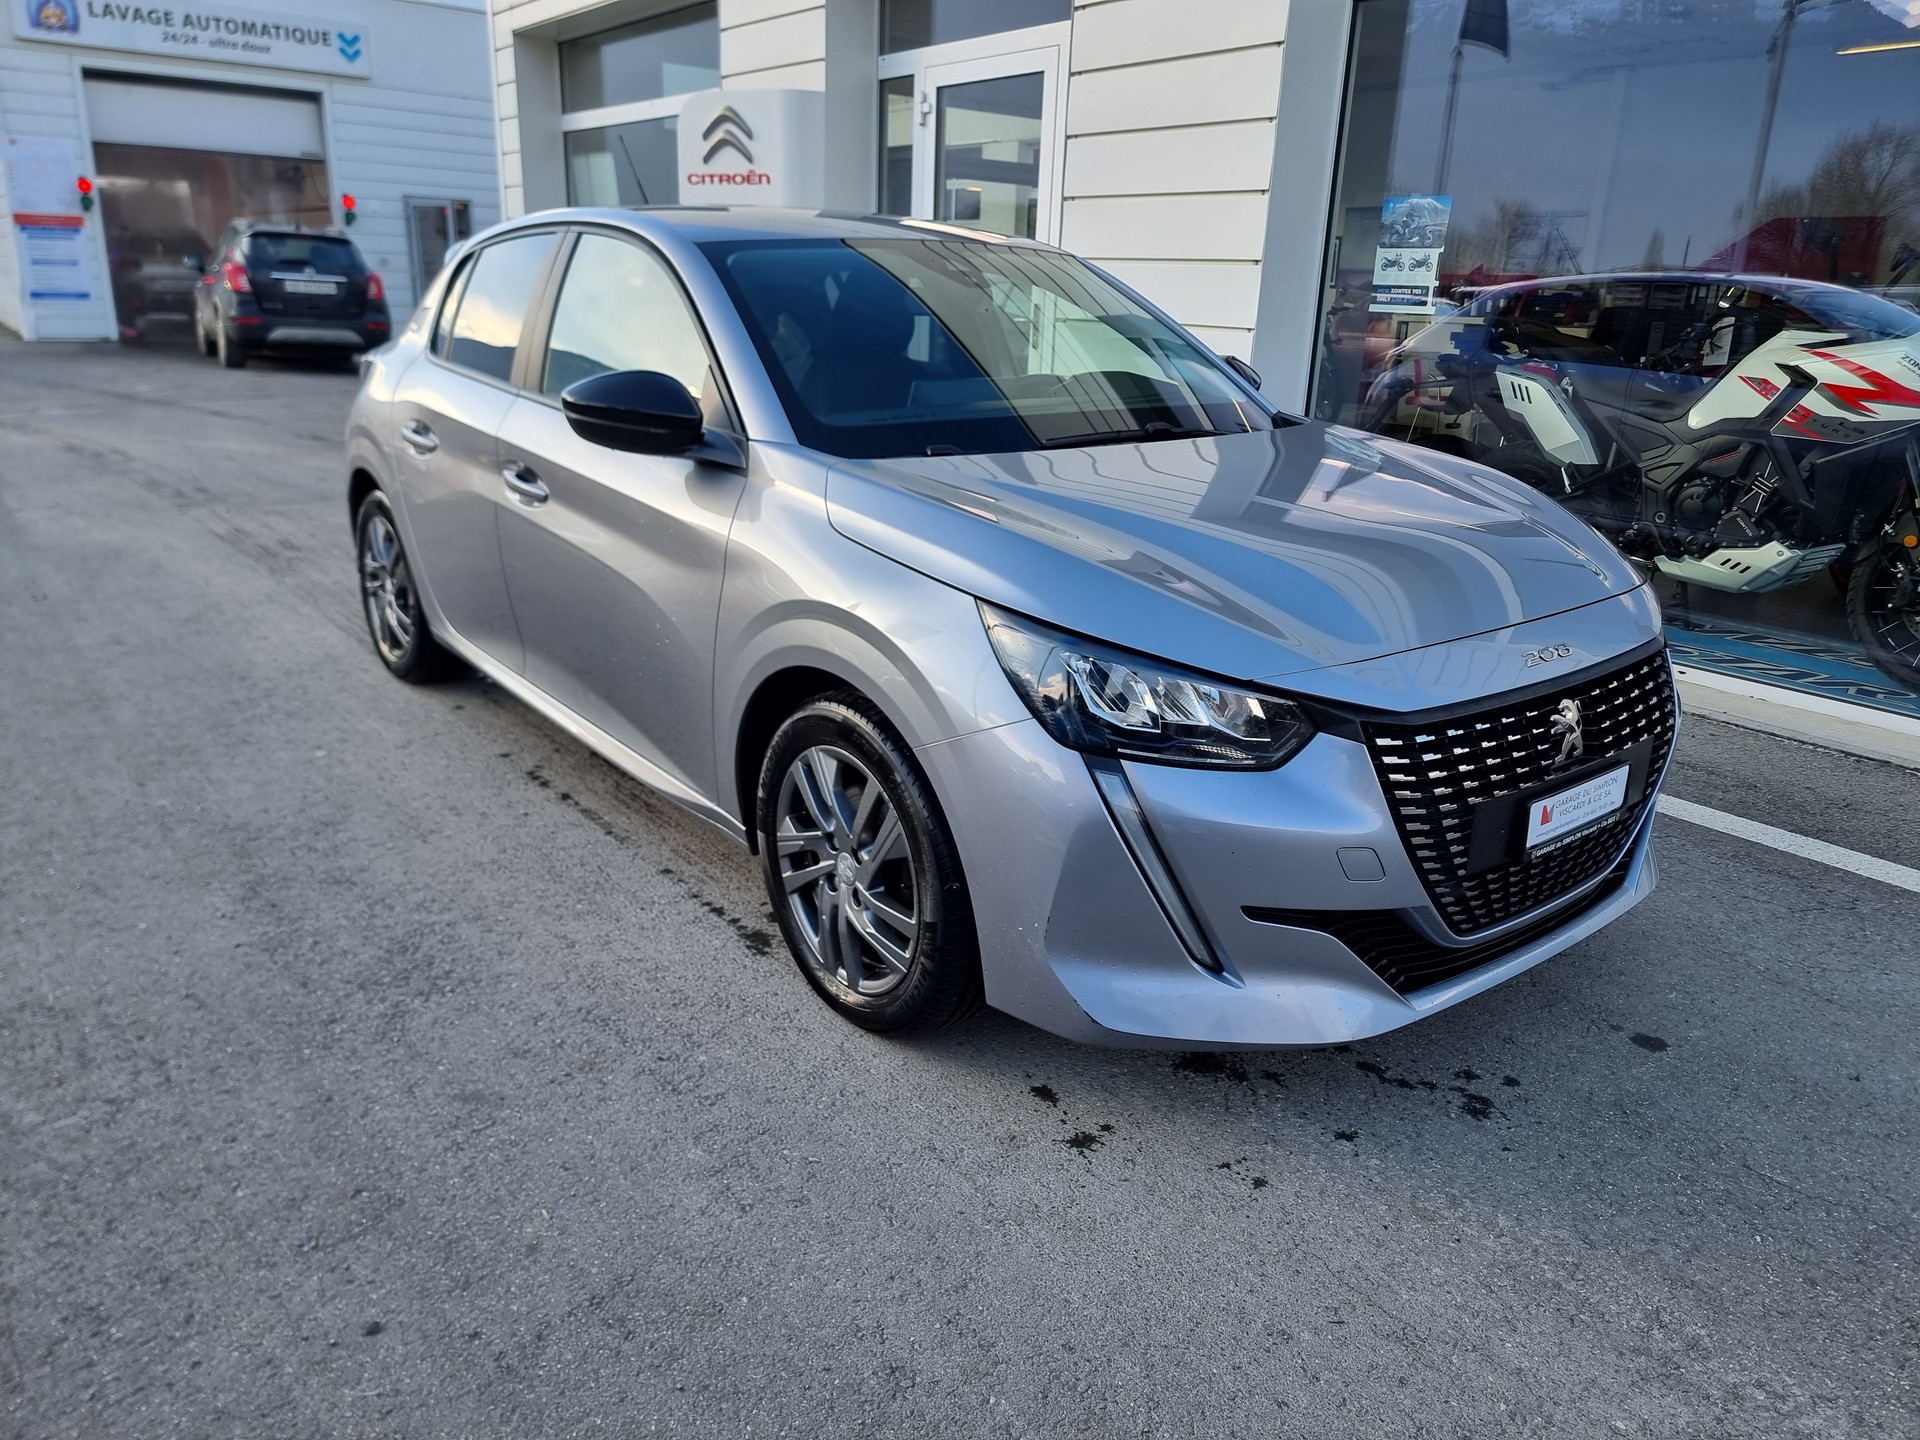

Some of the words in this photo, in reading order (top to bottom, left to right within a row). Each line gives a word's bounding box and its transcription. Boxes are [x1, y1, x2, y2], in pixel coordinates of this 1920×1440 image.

[87, 1, 176, 28] LAVAGE
[182, 12, 333, 48] AUTOMATIQUE
[161, 30, 199, 46] 24/24
[687, 169, 771, 186] CITROËN
[1522, 643, 1573, 668] 208
[1555, 792, 1581, 808] GARAGE
[1582, 786, 1592, 798] DU
[1593, 776, 1618, 793] SIMPLON
[1559, 799, 1585, 817] VISCARDI
[1536, 844, 1556, 857] GARAGE
[1562, 832, 1581, 844] SIMPLON
